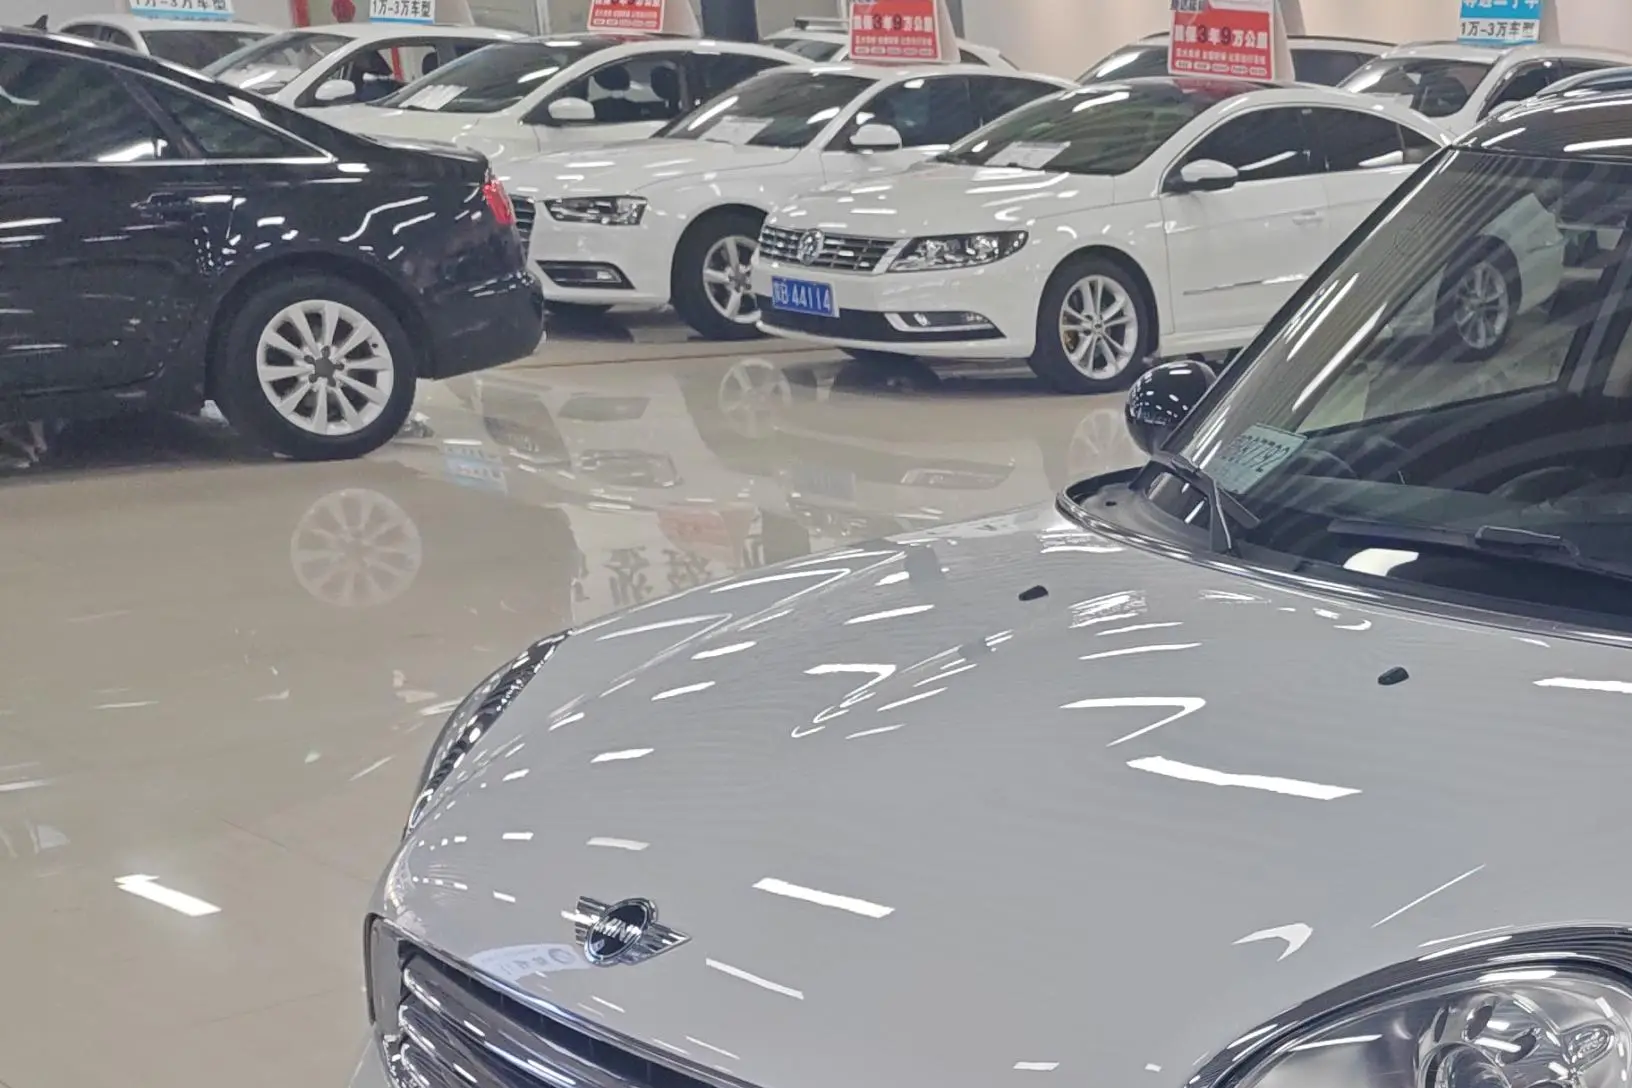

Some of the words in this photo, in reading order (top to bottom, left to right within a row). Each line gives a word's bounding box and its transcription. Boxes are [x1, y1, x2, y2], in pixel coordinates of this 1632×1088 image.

[373, 0, 431, 17] 1万-3万车型
[1461, 21, 1535, 38] 1万-3万车型
